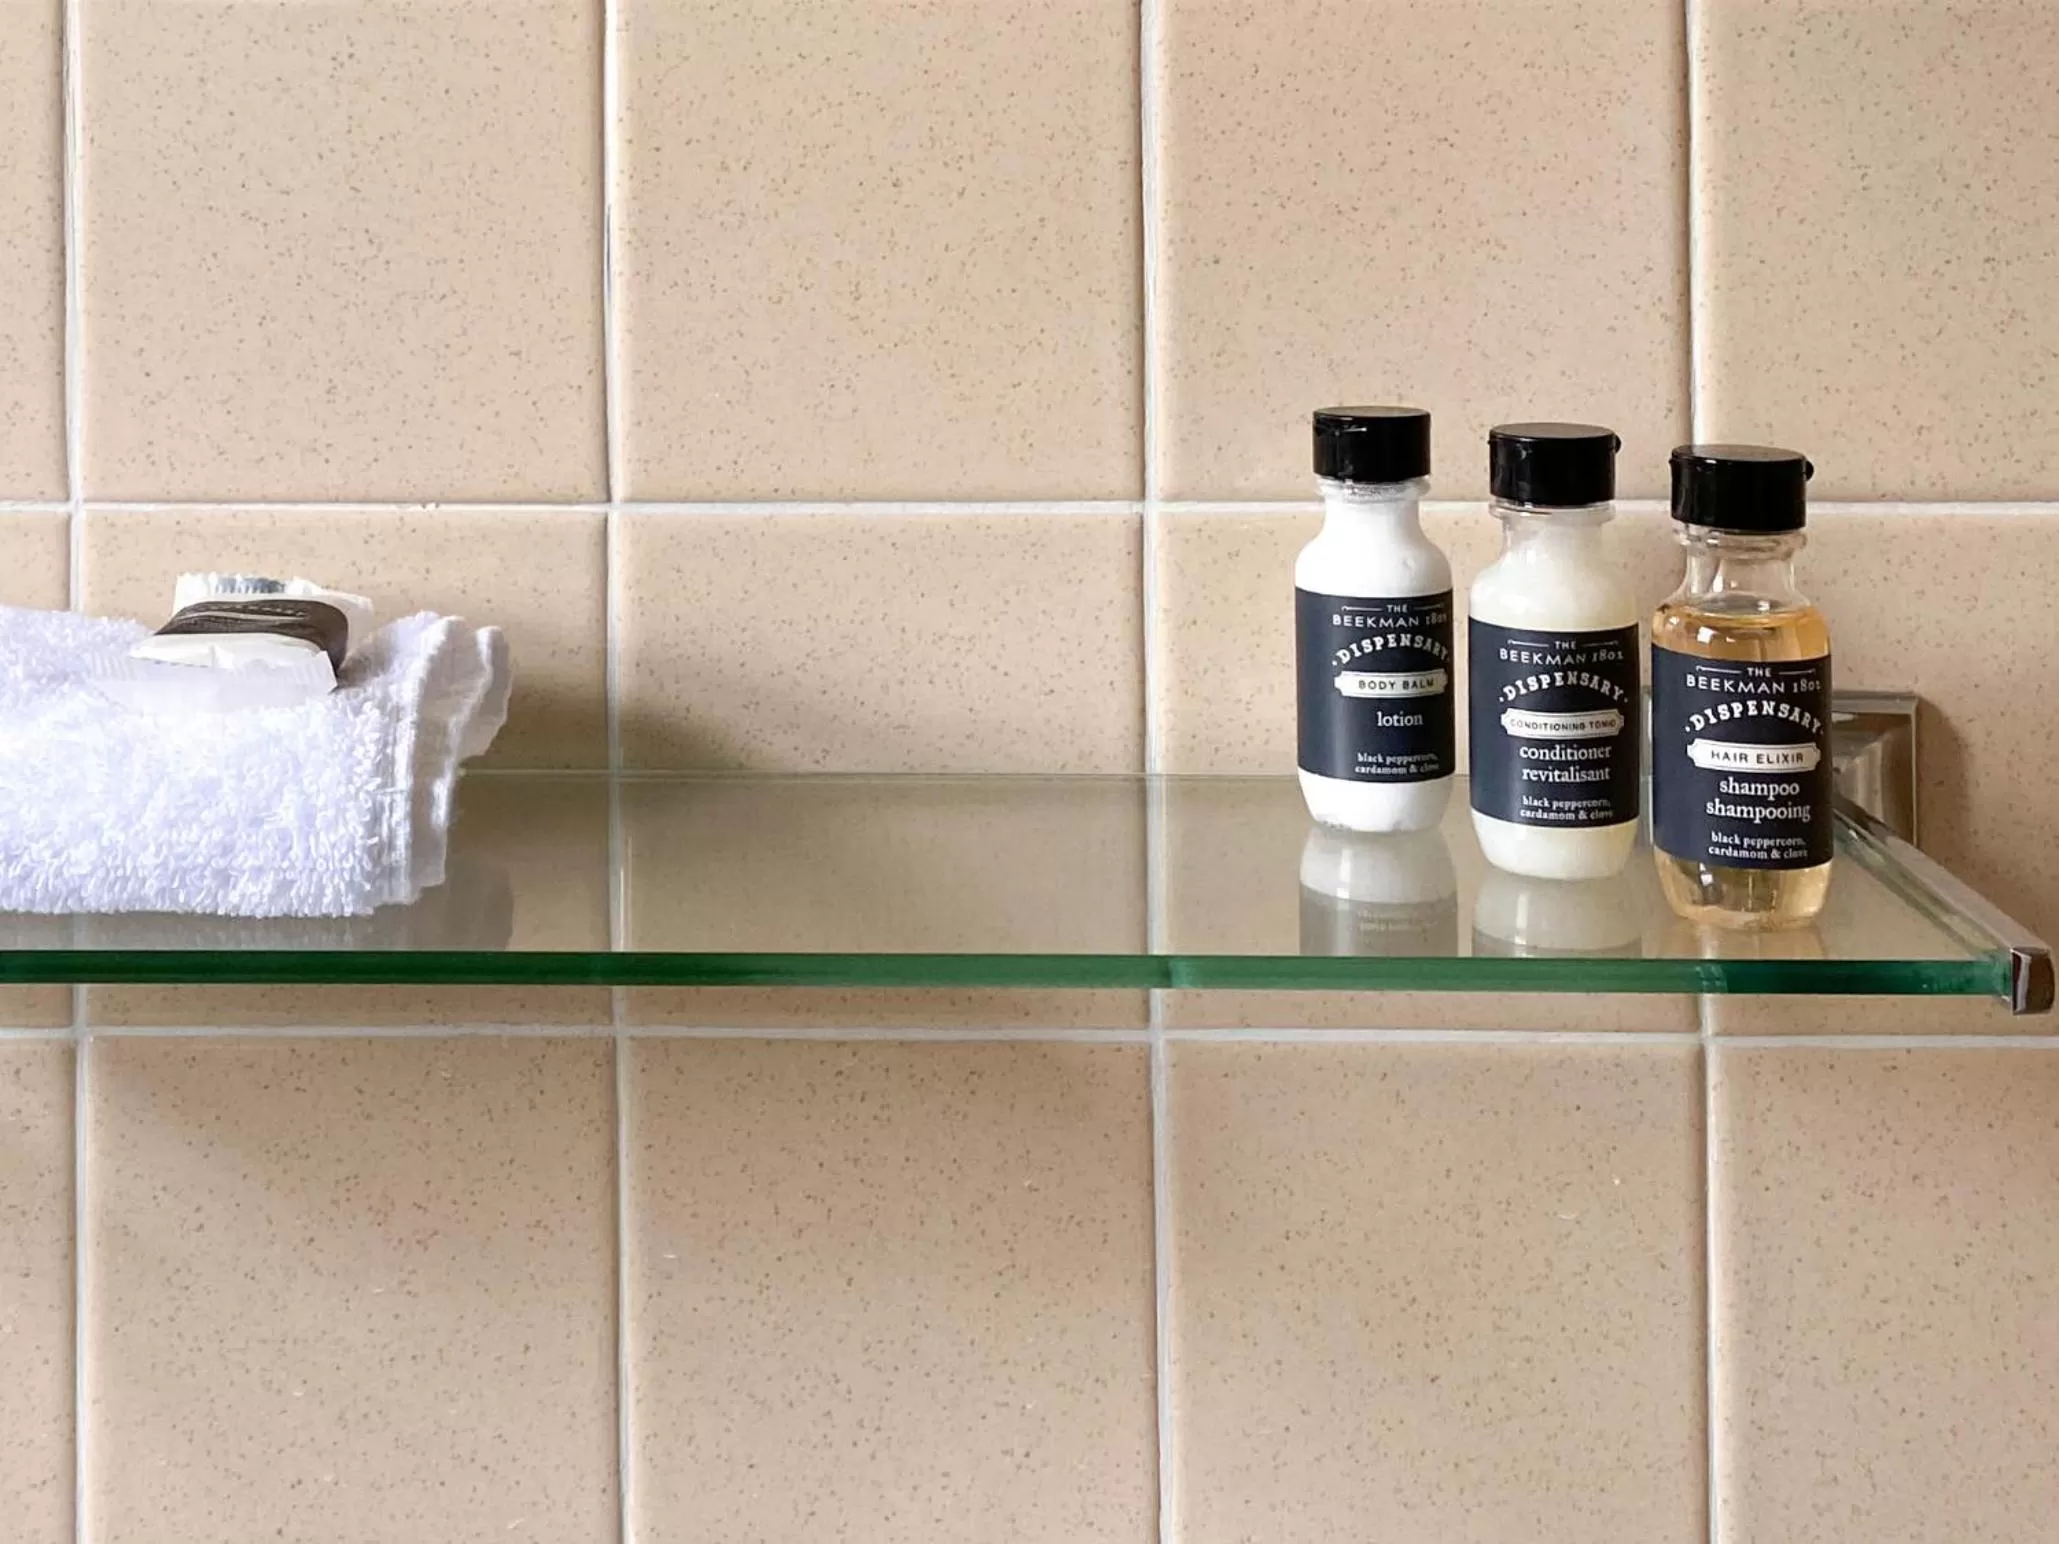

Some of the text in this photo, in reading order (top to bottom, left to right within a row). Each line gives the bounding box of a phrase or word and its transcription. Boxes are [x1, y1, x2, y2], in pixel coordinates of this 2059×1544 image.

[1387, 604, 1408, 613] THE
[1332, 614, 1420, 628] BEEKMAN
[1335, 633, 1449, 664] DISPENSARY
[1555, 640, 1576, 650] THE
[1499, 648, 1587, 665] BEEKMAN
[1747, 667, 1771, 677] THE
[1358, 678, 1435, 690] BODY BALM
[1501, 670, 1624, 701] DISPENSARY
[1686, 674, 1784, 694] BEEKMAN
[1376, 711, 1423, 727] lotion
[1689, 700, 1822, 734] DISPENSARY
[1510, 718, 1617, 731] CONDITIONING TONIC
[1357, 752, 1384, 763] black
[1519, 744, 1612, 761] conditioner
[1711, 750, 1804, 764] HAIR ELIXIR
[1521, 766, 1611, 783] revitalisant
[1719, 776, 1800, 800] shampoo
[1522, 795, 1550, 807] black
[1520, 809, 1575, 820] cardamom
[1578, 810, 1588, 819] &
[1706, 798, 1811, 824] shampooing
[1711, 830, 1741, 844] black
[1708, 845, 1768, 859] cardamom
[1770, 848, 1781, 859] &
